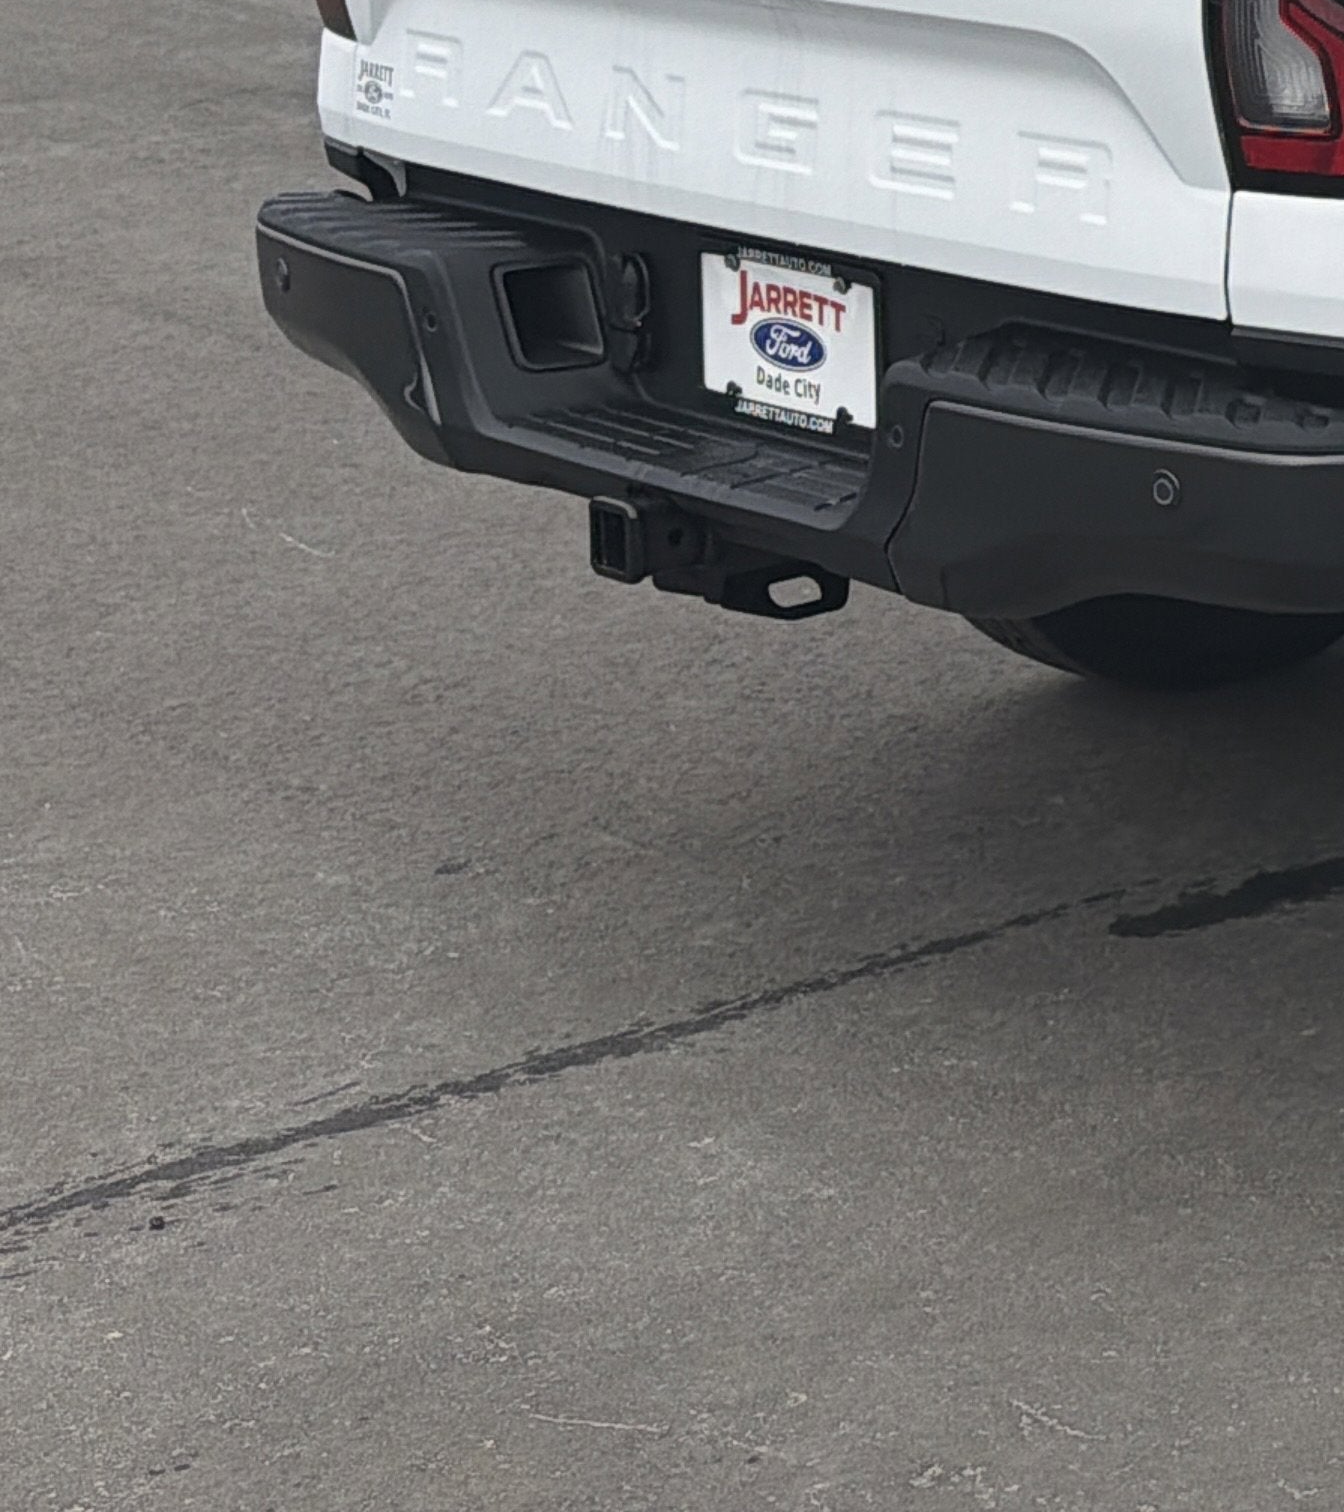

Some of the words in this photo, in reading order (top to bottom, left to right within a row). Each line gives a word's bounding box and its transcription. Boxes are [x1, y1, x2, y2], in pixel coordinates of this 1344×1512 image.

[399, 28, 1113, 226] RANGER
[731, 270, 847, 333] JARRETT
[765, 323, 812, 365] Ford
[756, 365, 790, 396] Dade
[794, 378, 821, 405] City
[734, 398, 834, 435] JARRETTAUTO.COM
